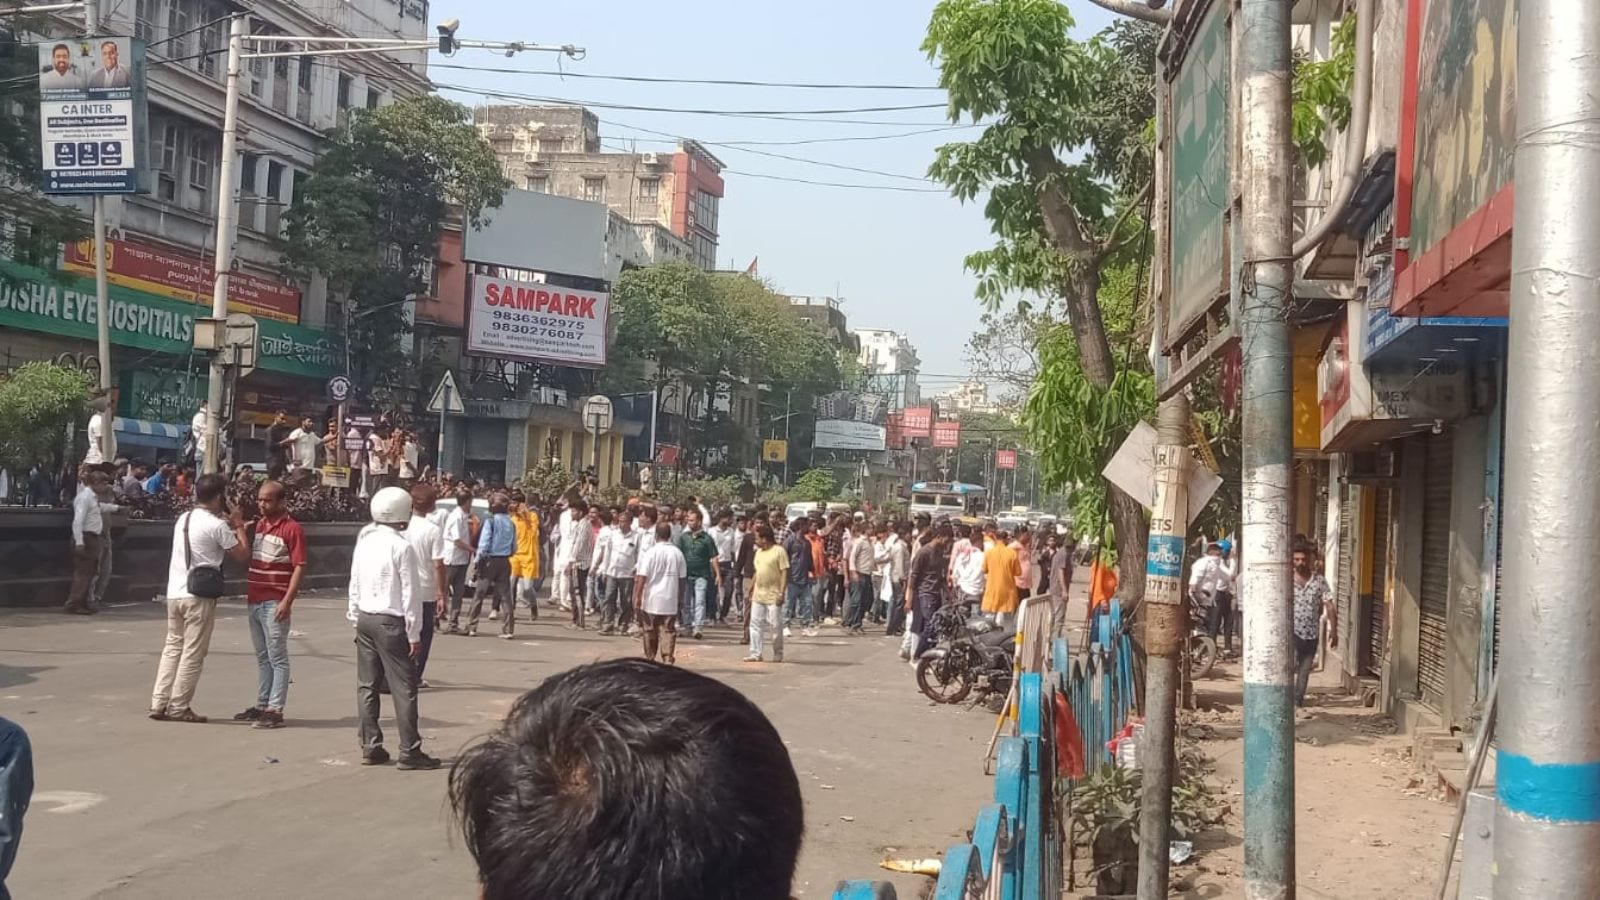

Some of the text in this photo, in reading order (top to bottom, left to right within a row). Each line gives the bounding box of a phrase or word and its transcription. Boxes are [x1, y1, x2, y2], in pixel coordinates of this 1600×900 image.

[61, 104, 113, 115] CA INTER
[168, 270, 201, 283] punjab
[203, 280, 238, 292] naal
[240, 286, 258, 298] bank
[62, 290, 97, 324] EYE
[485, 283, 596, 319] SAMPARK
[492, 321, 584, 340] 9830276087
[493, 310, 585, 330] 9836362975
[260, 333, 293, 355] আই
